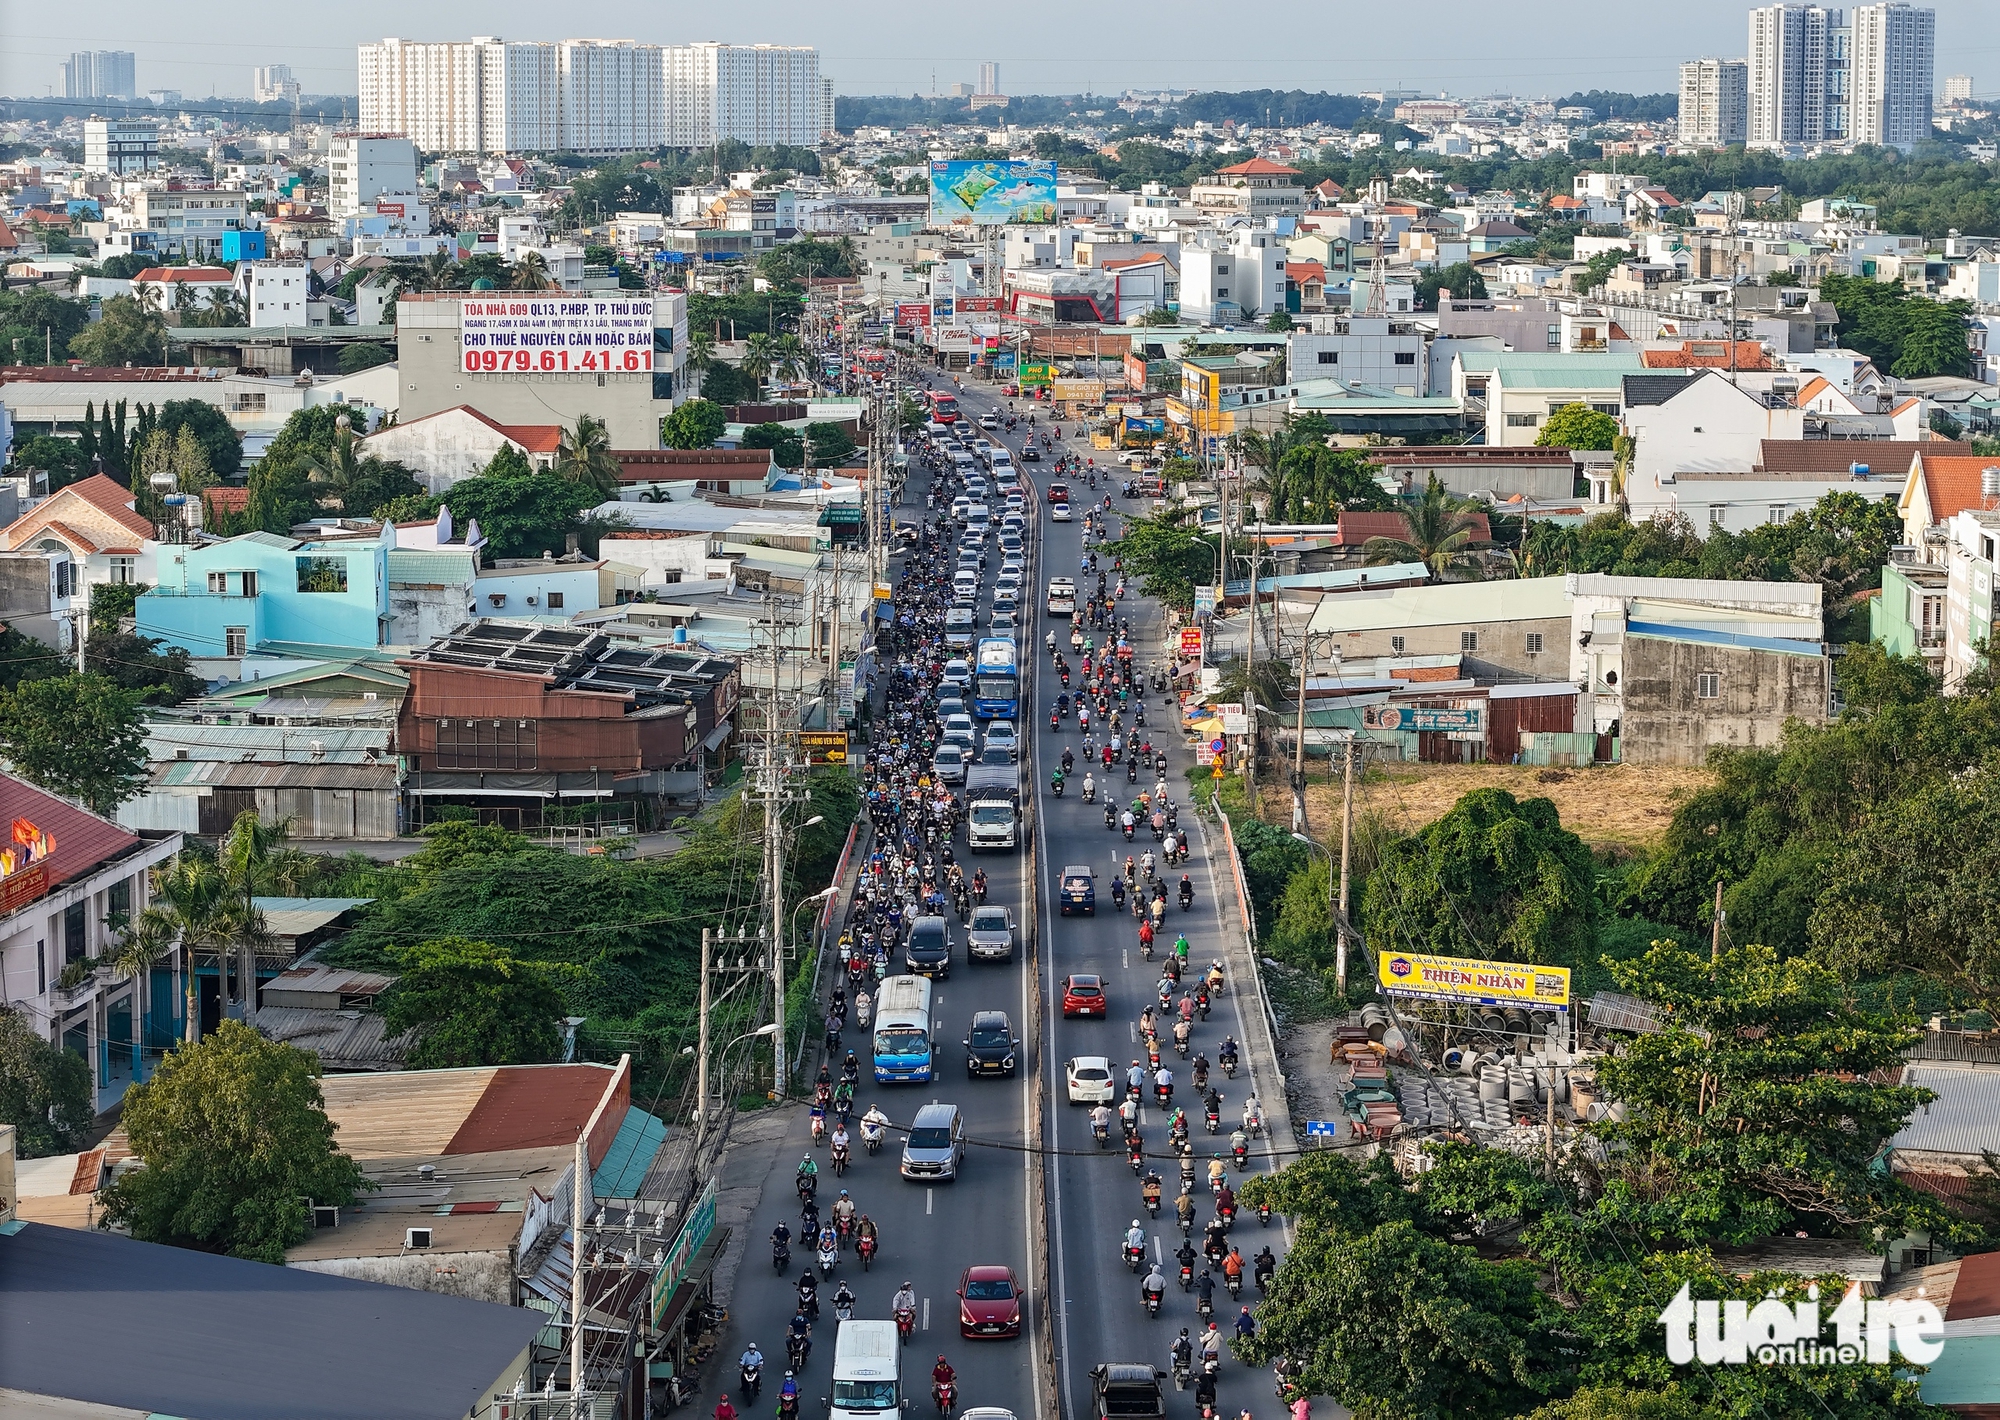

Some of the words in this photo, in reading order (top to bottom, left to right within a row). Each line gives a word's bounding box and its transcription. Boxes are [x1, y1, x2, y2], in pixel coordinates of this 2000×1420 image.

[464, 301, 483, 315] TÒA
[486, 301, 506, 315] NHÀ
[509, 304, 527, 315] 609
[530, 303, 557, 317] QL13,
[560, 303, 589, 316] P.HBP,
[594, 304, 607, 315] TP.
[611, 300, 629, 315] THỦ
[632, 301, 652, 315] ĐỨC
[520, 319, 530, 327] DÀI
[551, 318, 565, 329] MỘT
[567, 319, 582, 329] TRỆT
[584, 319, 588, 327] X
[590, 319, 594, 327] 3
[612, 319, 632, 327] THANG
[634, 318, 648, 327] MÁY
[464, 333, 486, 346] CHO
[490, 331, 517, 346] THUÊ
[521, 331, 565, 346] NGUYÊN
[569, 331, 591, 346] CĂN
[596, 331, 624, 348] HOẶC
[629, 330, 651, 345] BÁN
[466, 350, 651, 371] 0979.61.41.61
[811, 736, 823, 745] HÀNG
[833, 736, 845, 745] SÔNG
[1392, 962, 1410, 973] TN
[1450, 960, 1469, 968] XUẤT
[1421, 968, 1472, 986] THIỆN
[1477, 974, 1526, 990] NHÂN
